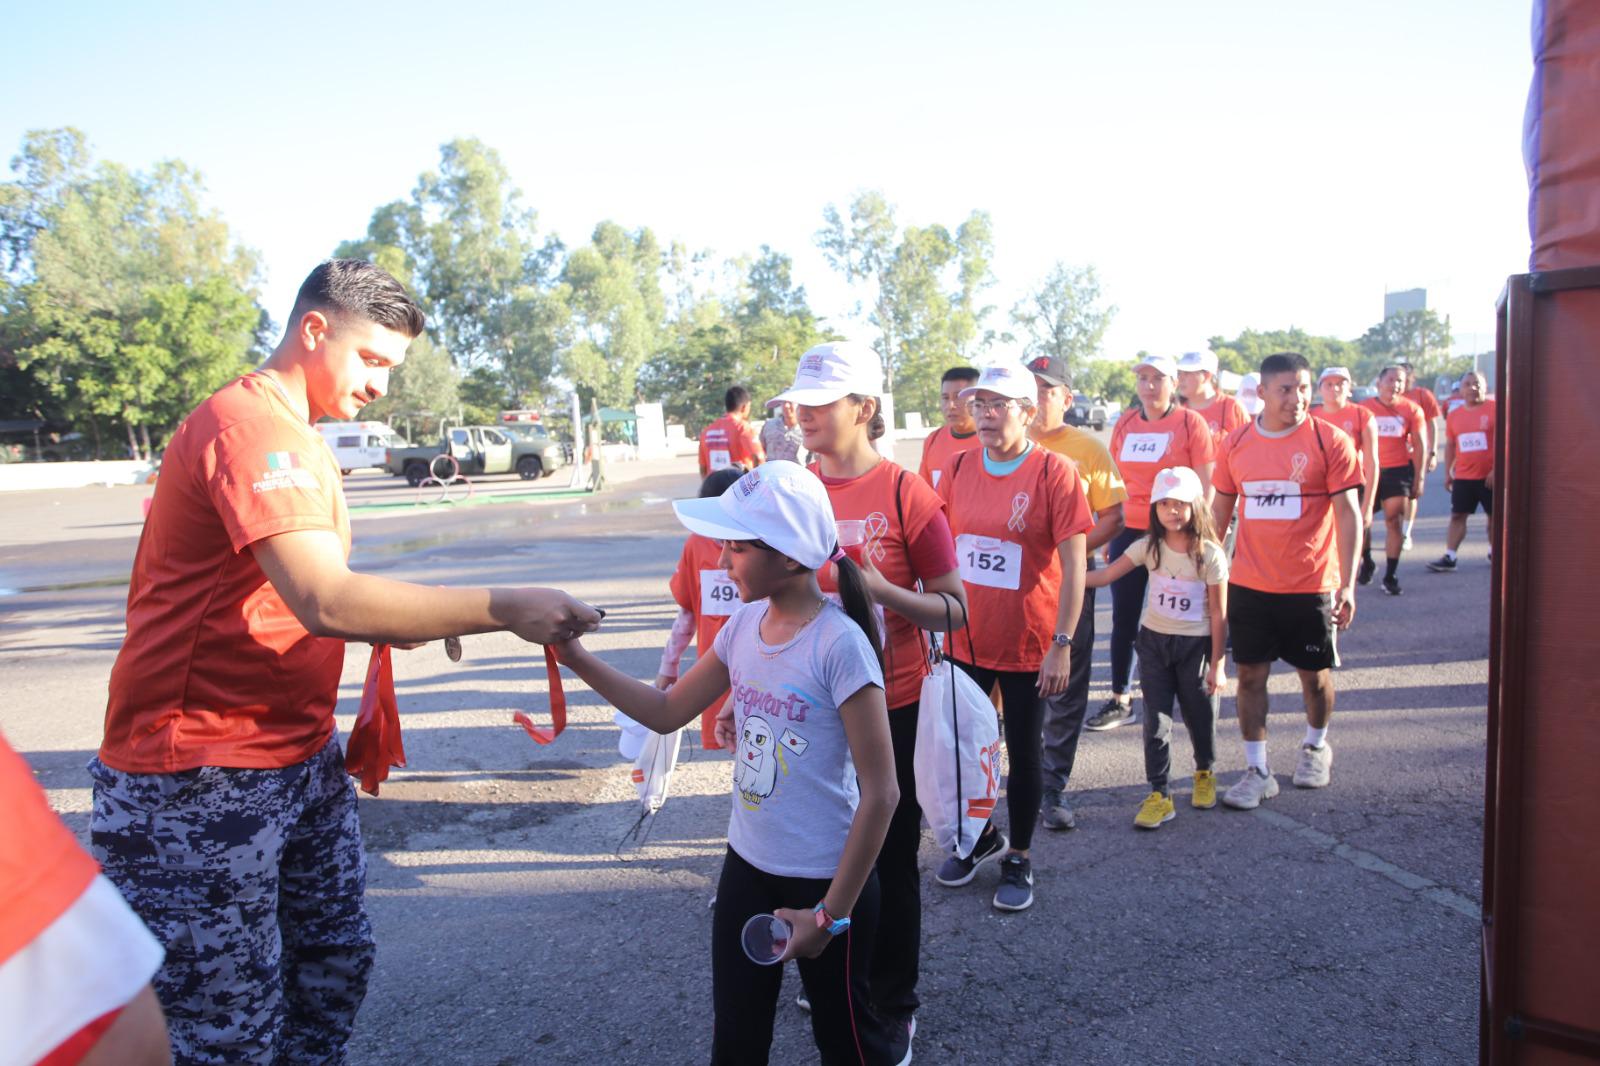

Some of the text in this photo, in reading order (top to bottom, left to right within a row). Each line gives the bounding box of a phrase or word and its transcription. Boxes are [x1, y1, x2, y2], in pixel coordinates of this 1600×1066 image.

[1132, 443, 1156, 452] 144
[967, 551, 1006, 573] 152
[1158, 593, 1192, 612] 119
